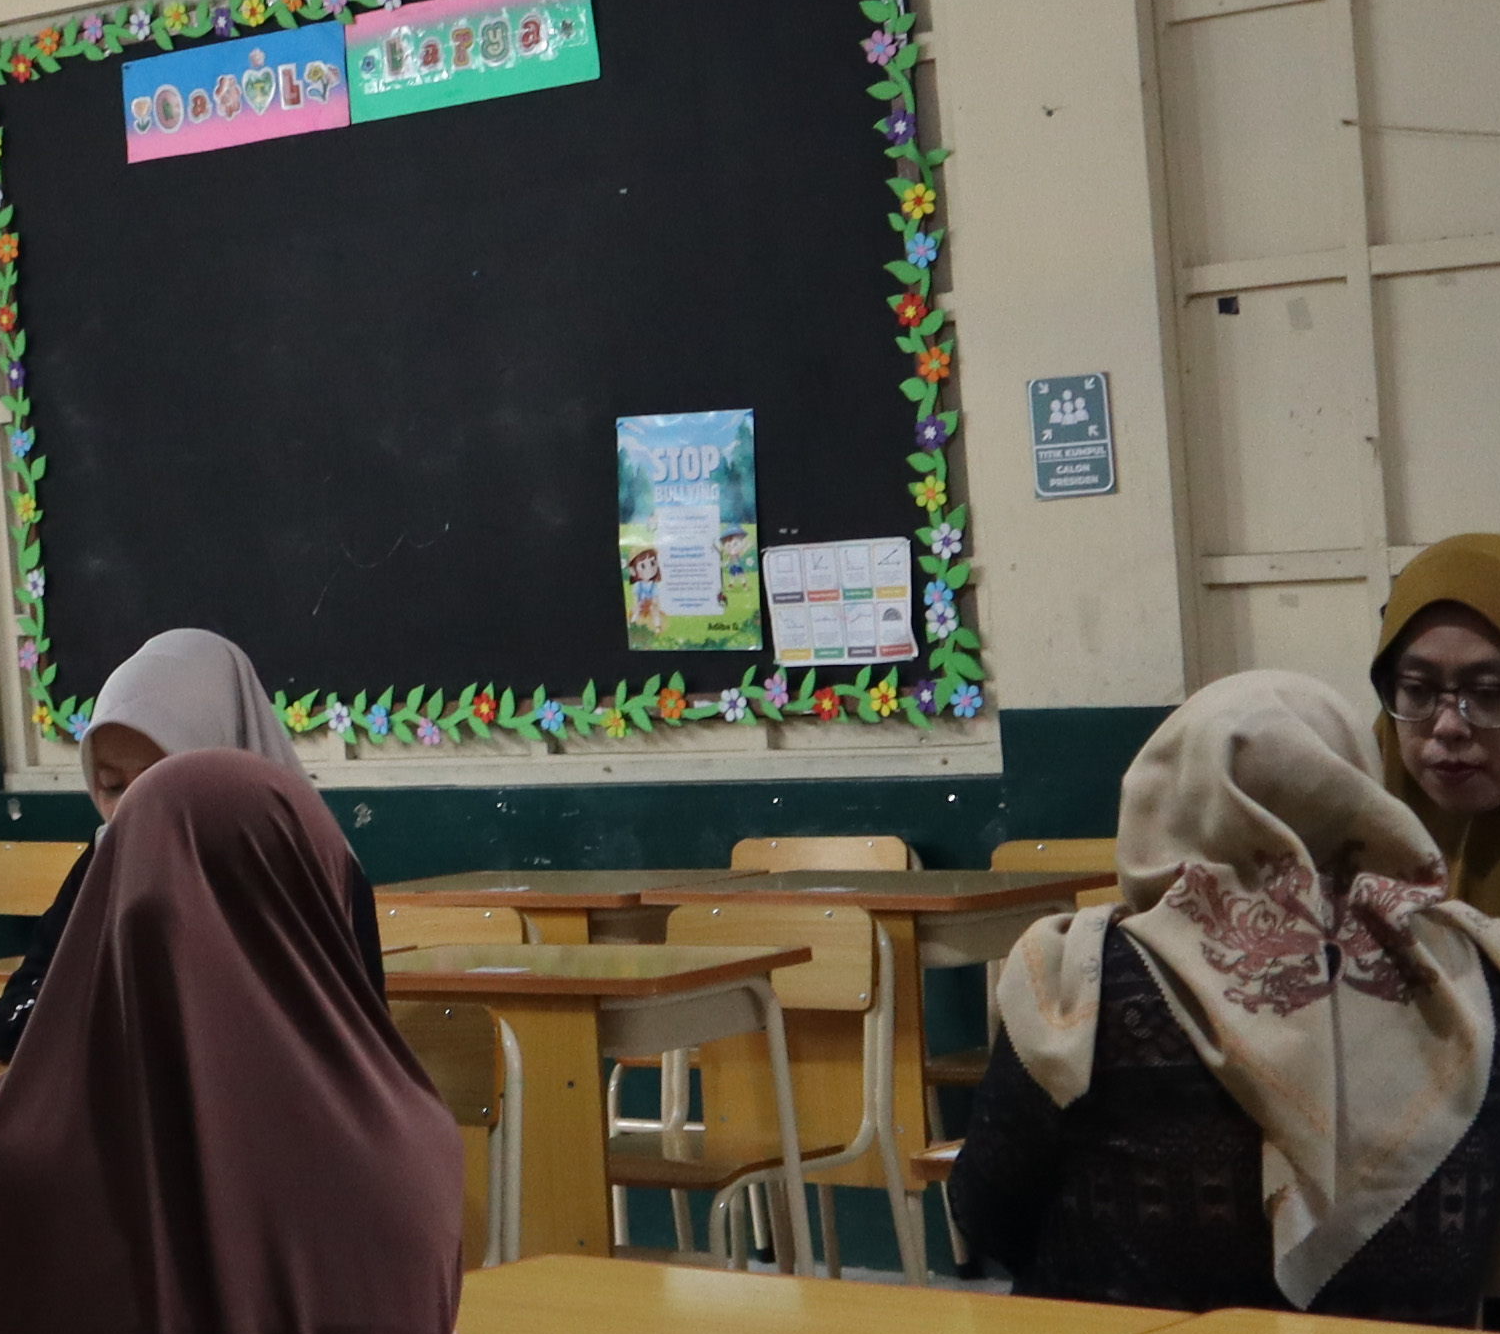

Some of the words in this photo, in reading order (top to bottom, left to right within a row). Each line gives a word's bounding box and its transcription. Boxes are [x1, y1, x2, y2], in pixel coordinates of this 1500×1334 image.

[1039, 449, 1063, 460] TITIK
[1065, 446, 1107, 458] KUMPUL
[652, 444, 721, 484] STOP
[1056, 464, 1091, 475] CALON
[1049, 475, 1099, 487] PRESIDEN
[655, 482, 721, 505] BULLYING
